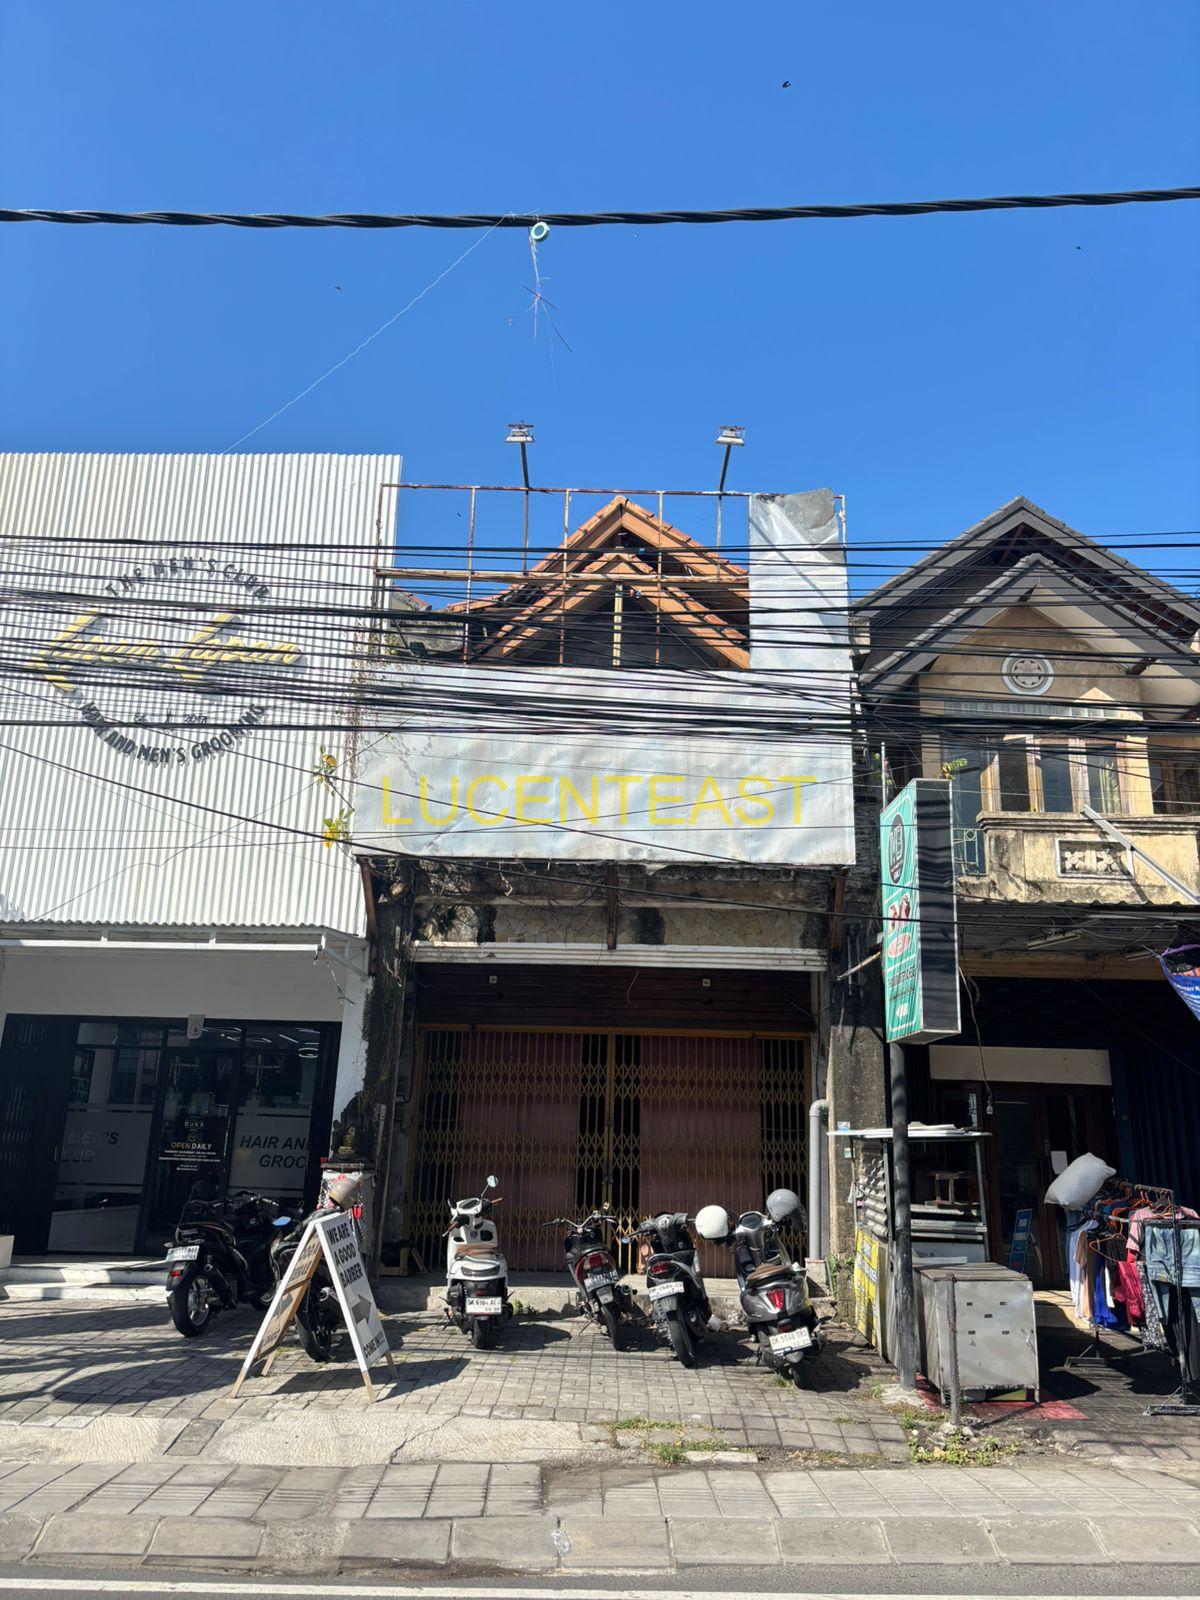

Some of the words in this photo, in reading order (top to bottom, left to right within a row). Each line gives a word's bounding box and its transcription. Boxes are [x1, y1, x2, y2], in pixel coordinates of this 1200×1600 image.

[104, 730, 138, 756] AND
[136, 744, 187, 764] MEN'S
[171, 1142, 191, 1150] OPEN
[191, 1143, 213, 1151] DAILY
[240, 1135, 280, 1149] HAIR
[327, 1227, 339, 1245] WE
[337, 1222, 350, 1241] ARE
[339, 1243, 357, 1264] GOOD
[340, 1262, 363, 1288] BARBER
